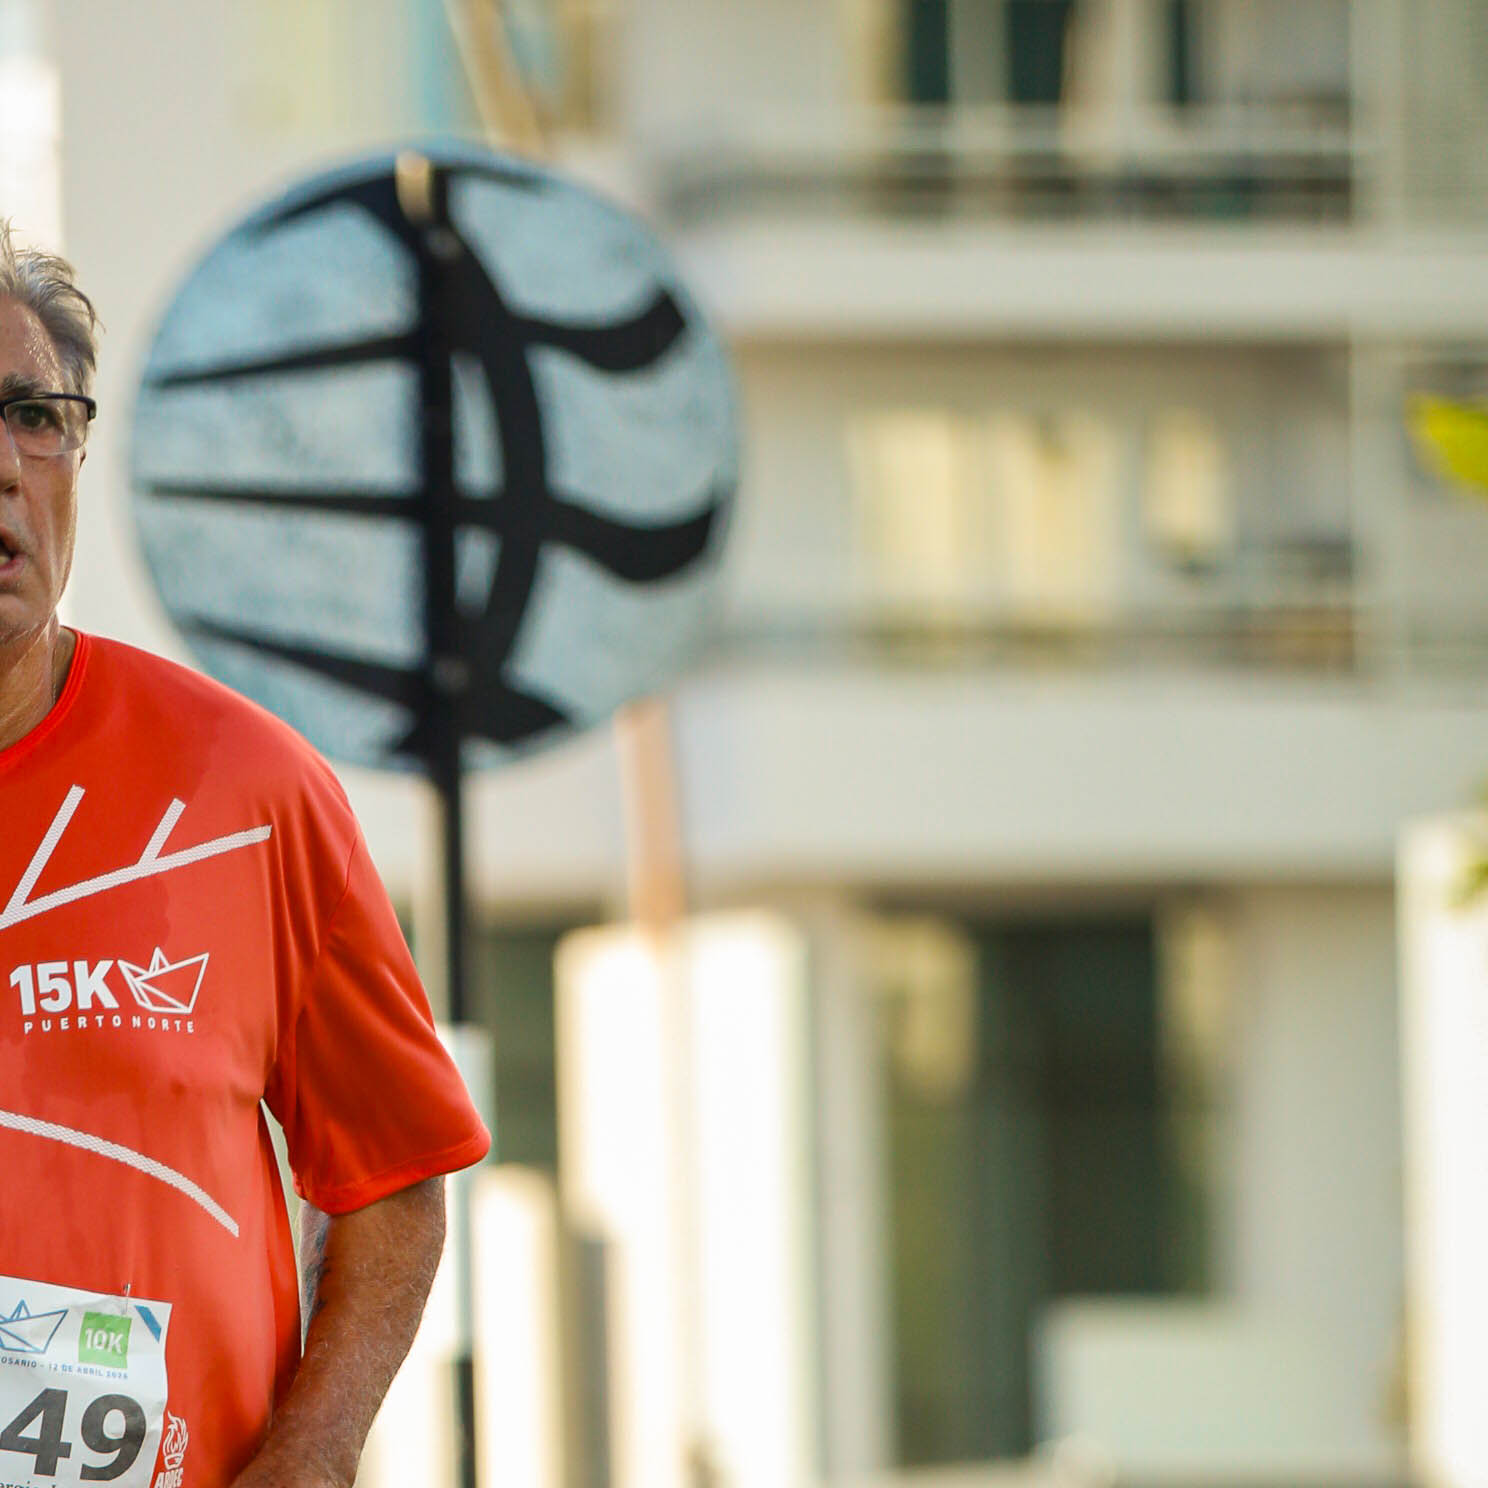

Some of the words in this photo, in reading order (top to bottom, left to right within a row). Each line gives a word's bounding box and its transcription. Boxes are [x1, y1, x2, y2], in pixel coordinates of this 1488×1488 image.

[9, 959, 120, 1015] 15K
[23, 1015, 123, 1034] PUERTO
[131, 1015, 196, 1034] NORTE
[84, 1328, 124, 1355] 10K
[61, 1364, 73, 1373] DE
[77, 1367, 104, 1377] ABRIL
